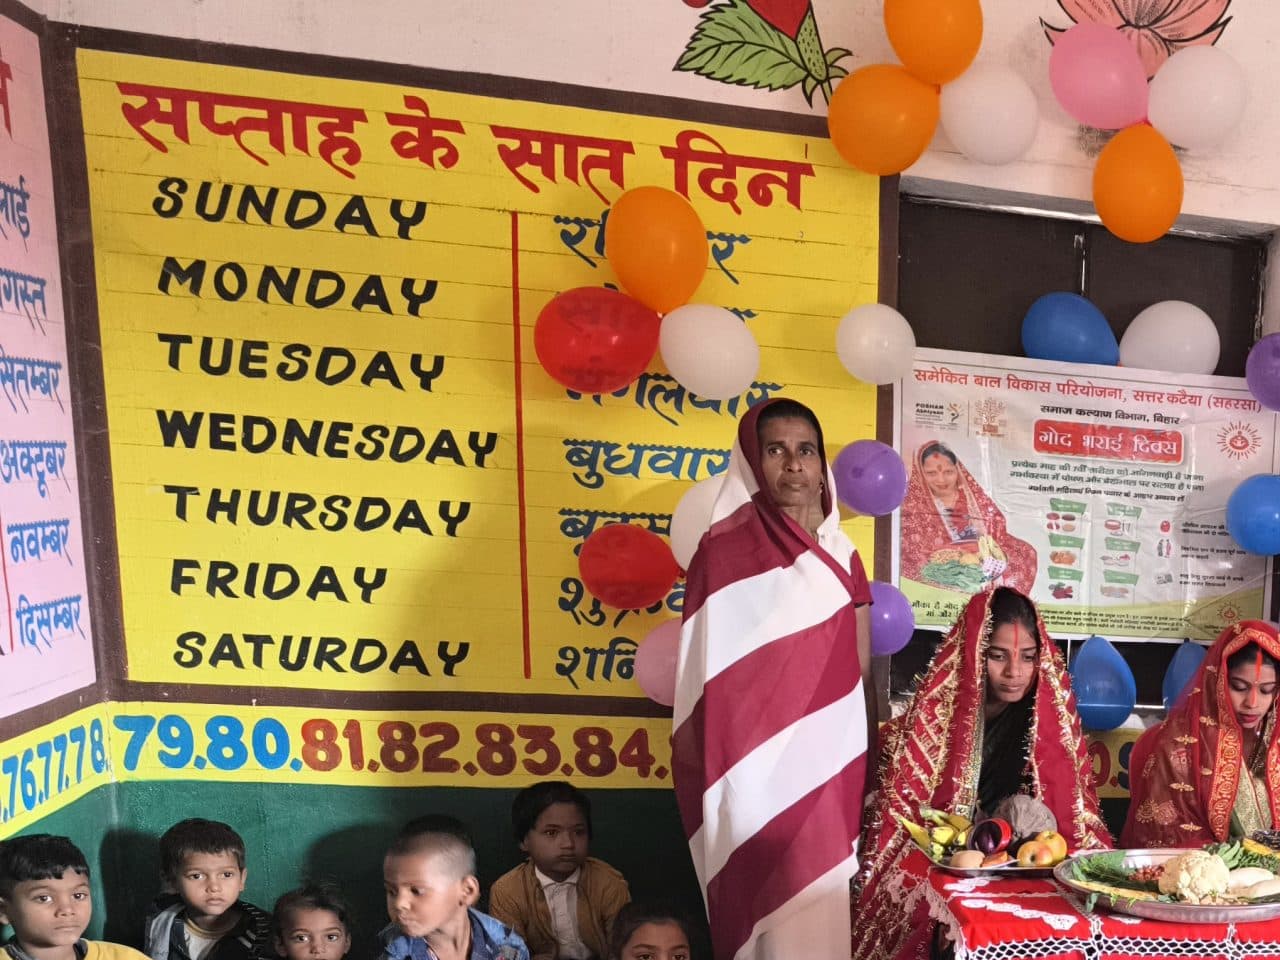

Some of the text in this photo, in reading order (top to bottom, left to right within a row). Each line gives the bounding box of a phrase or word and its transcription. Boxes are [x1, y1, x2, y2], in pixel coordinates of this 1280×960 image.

[115, 82, 816, 215] सप्ताह के सात दिन
[152, 177, 427, 240] SUNDAY
[159, 255, 439, 318] MONDAY
[158, 333, 446, 392] TUESDAY
[914, 366, 968, 386] समेकित
[974, 374, 1002, 389] बाल
[1007, 374, 1051, 393] विकास
[157, 409, 499, 468] WEDNESDAY
[1083, 432, 1122, 452] भराई
[1132, 433, 1177, 455] दिवस
[165, 484, 471, 537] THURSDAY
[171, 558, 388, 605] FRIDAY
[172, 631, 470, 678] SATURDAY
